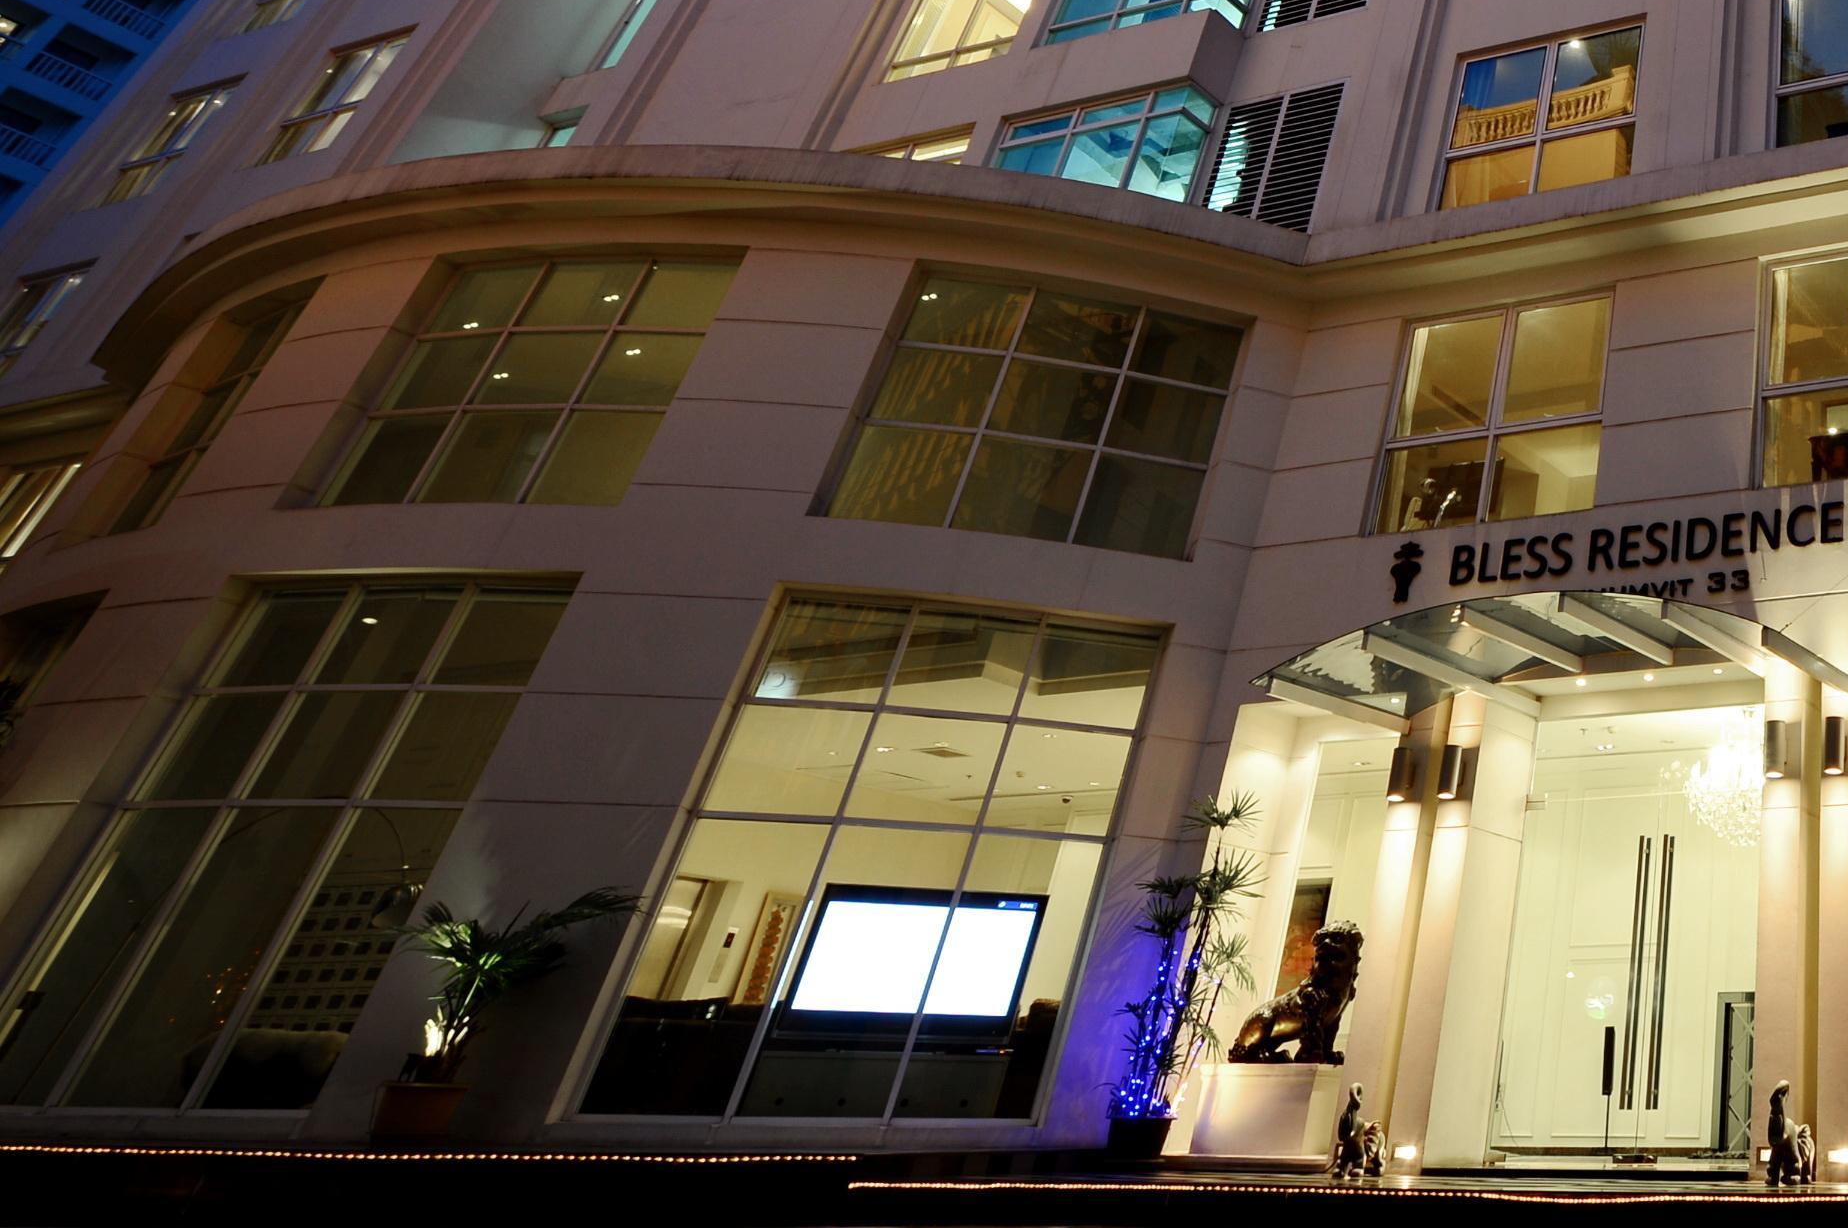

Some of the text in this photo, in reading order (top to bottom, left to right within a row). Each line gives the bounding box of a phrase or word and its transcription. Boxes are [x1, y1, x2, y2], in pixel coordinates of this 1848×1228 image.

[1449, 501, 1845, 586] BLESS RESIDENCE
[1707, 569, 1750, 593] 33
